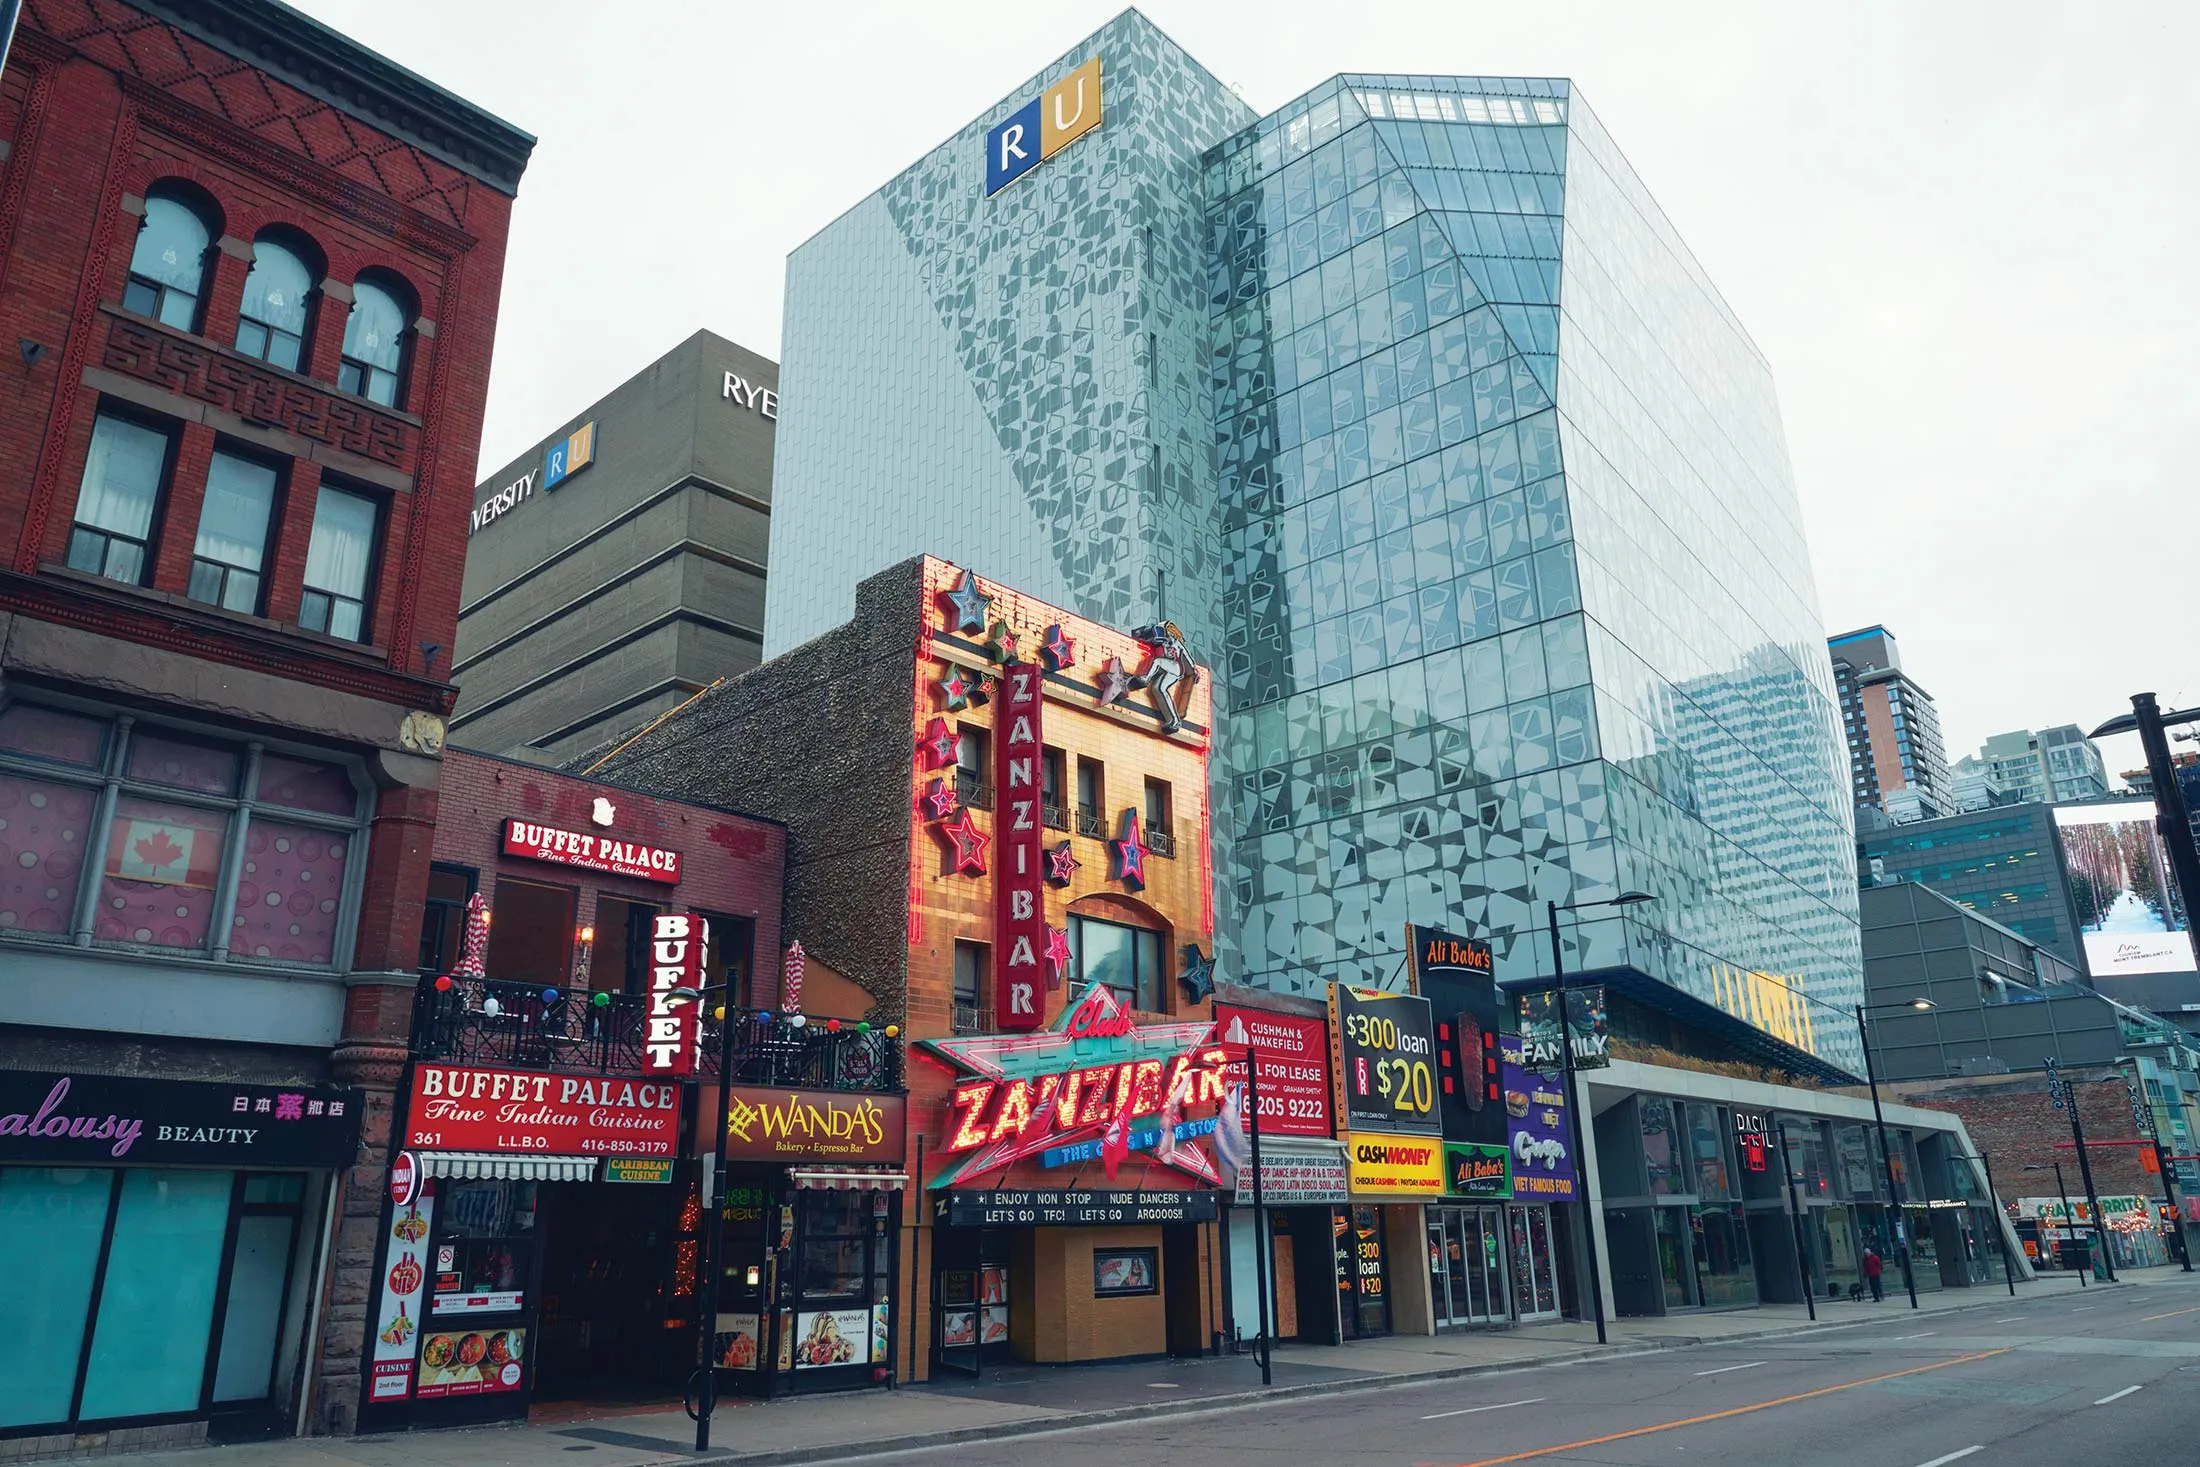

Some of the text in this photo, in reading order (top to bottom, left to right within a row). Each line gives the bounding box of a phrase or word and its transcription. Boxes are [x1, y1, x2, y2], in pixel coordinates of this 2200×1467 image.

[723, 371, 777, 419] RYE
[512, 822, 676, 872] BUFFET PALACE
[1008, 673, 1036, 1014] ZANZIBAR
[537, 849, 650, 877] Fine Indian Cuisine
[1427, 940, 1490, 968] Ali Baba's
[647, 915, 689, 1067] BUFFET
[1068, 996, 1131, 1039] Club
[1251, 1023, 1303, 1039] CUSHMAN &
[1347, 1013, 1428, 1055] $300 loan
[1251, 1035, 1304, 1051] WAKEFIELD
[1265, 1064, 1287, 1079] FOR
[1289, 1067, 1321, 1081] LEASE
[422, 1069, 674, 1110] BUFFET PALACE
[1283, 1084, 1305, 1093] GRAHAM
[1358, 1057, 1433, 1113] FOR $20
[950, 1050, 1228, 1152] ZANZIBAR
[1257, 1096, 1285, 1116] 205
[1288, 1099, 1323, 1118] 9222
[425, 1099, 666, 1130] Fine Indian Cuisine
[758, 1095, 883, 1145] WANDA'S
[157, 1126, 259, 1144] BEAUTY
[1736, 1113, 1773, 1148] BASIL
[414, 1132, 668, 1152] 361 L.L.B.O. 416-850-3179
[775, 1141, 864, 1155] Bakery Espresso Bar
[1061, 1144, 1090, 1164] THE
[1266, 1157, 1283, 1165] DEEJAYS
[1284, 1157, 1294, 1165] SHOP
[1305, 1158, 1317, 1166] GREAT
[1317, 1158, 1338, 1166] SELECTIONS
[1357, 1145, 1431, 1166] CASHMONEY
[611, 1160, 669, 1171] CARIBBEAN
[1260, 1168, 1270, 1177] POP
[1272, 1168, 1289, 1178] DANCE
[1290, 1168, 1311, 1178] HIP-HOP
[1458, 1158, 1504, 1179] Ali Baba's
[620, 1170, 661, 1180] CUISINE
[1355, 1176, 1440, 1187] CHEQUE CASHING PAYDAY ADVANCE
[1262, 1180, 1285, 1190] CALYPSO
[1286, 1180, 1300, 1190] LATIN
[1301, 1180, 1317, 1190] DISCO
[1513, 1176, 1571, 1194] VIET FAMOUS FOOD
[995, 1193, 1179, 1205] ENJOY NON STOP NUDE DANCERS
[1304, 1192, 1327, 1200] EUROPEAN
[1329, 1192, 1346, 1200] IMPORTS
[986, 1208, 1183, 1222] LET'S GO TFC! LET'S GO ARGOOOS!!
[1358, 1243, 1379, 1258] $300
[1359, 1259, 1380, 1274] loan
[1366, 1278, 1381, 1293] $20
[375, 1363, 410, 1373] CUISINE
[378, 1381, 390, 1389] 2nd
